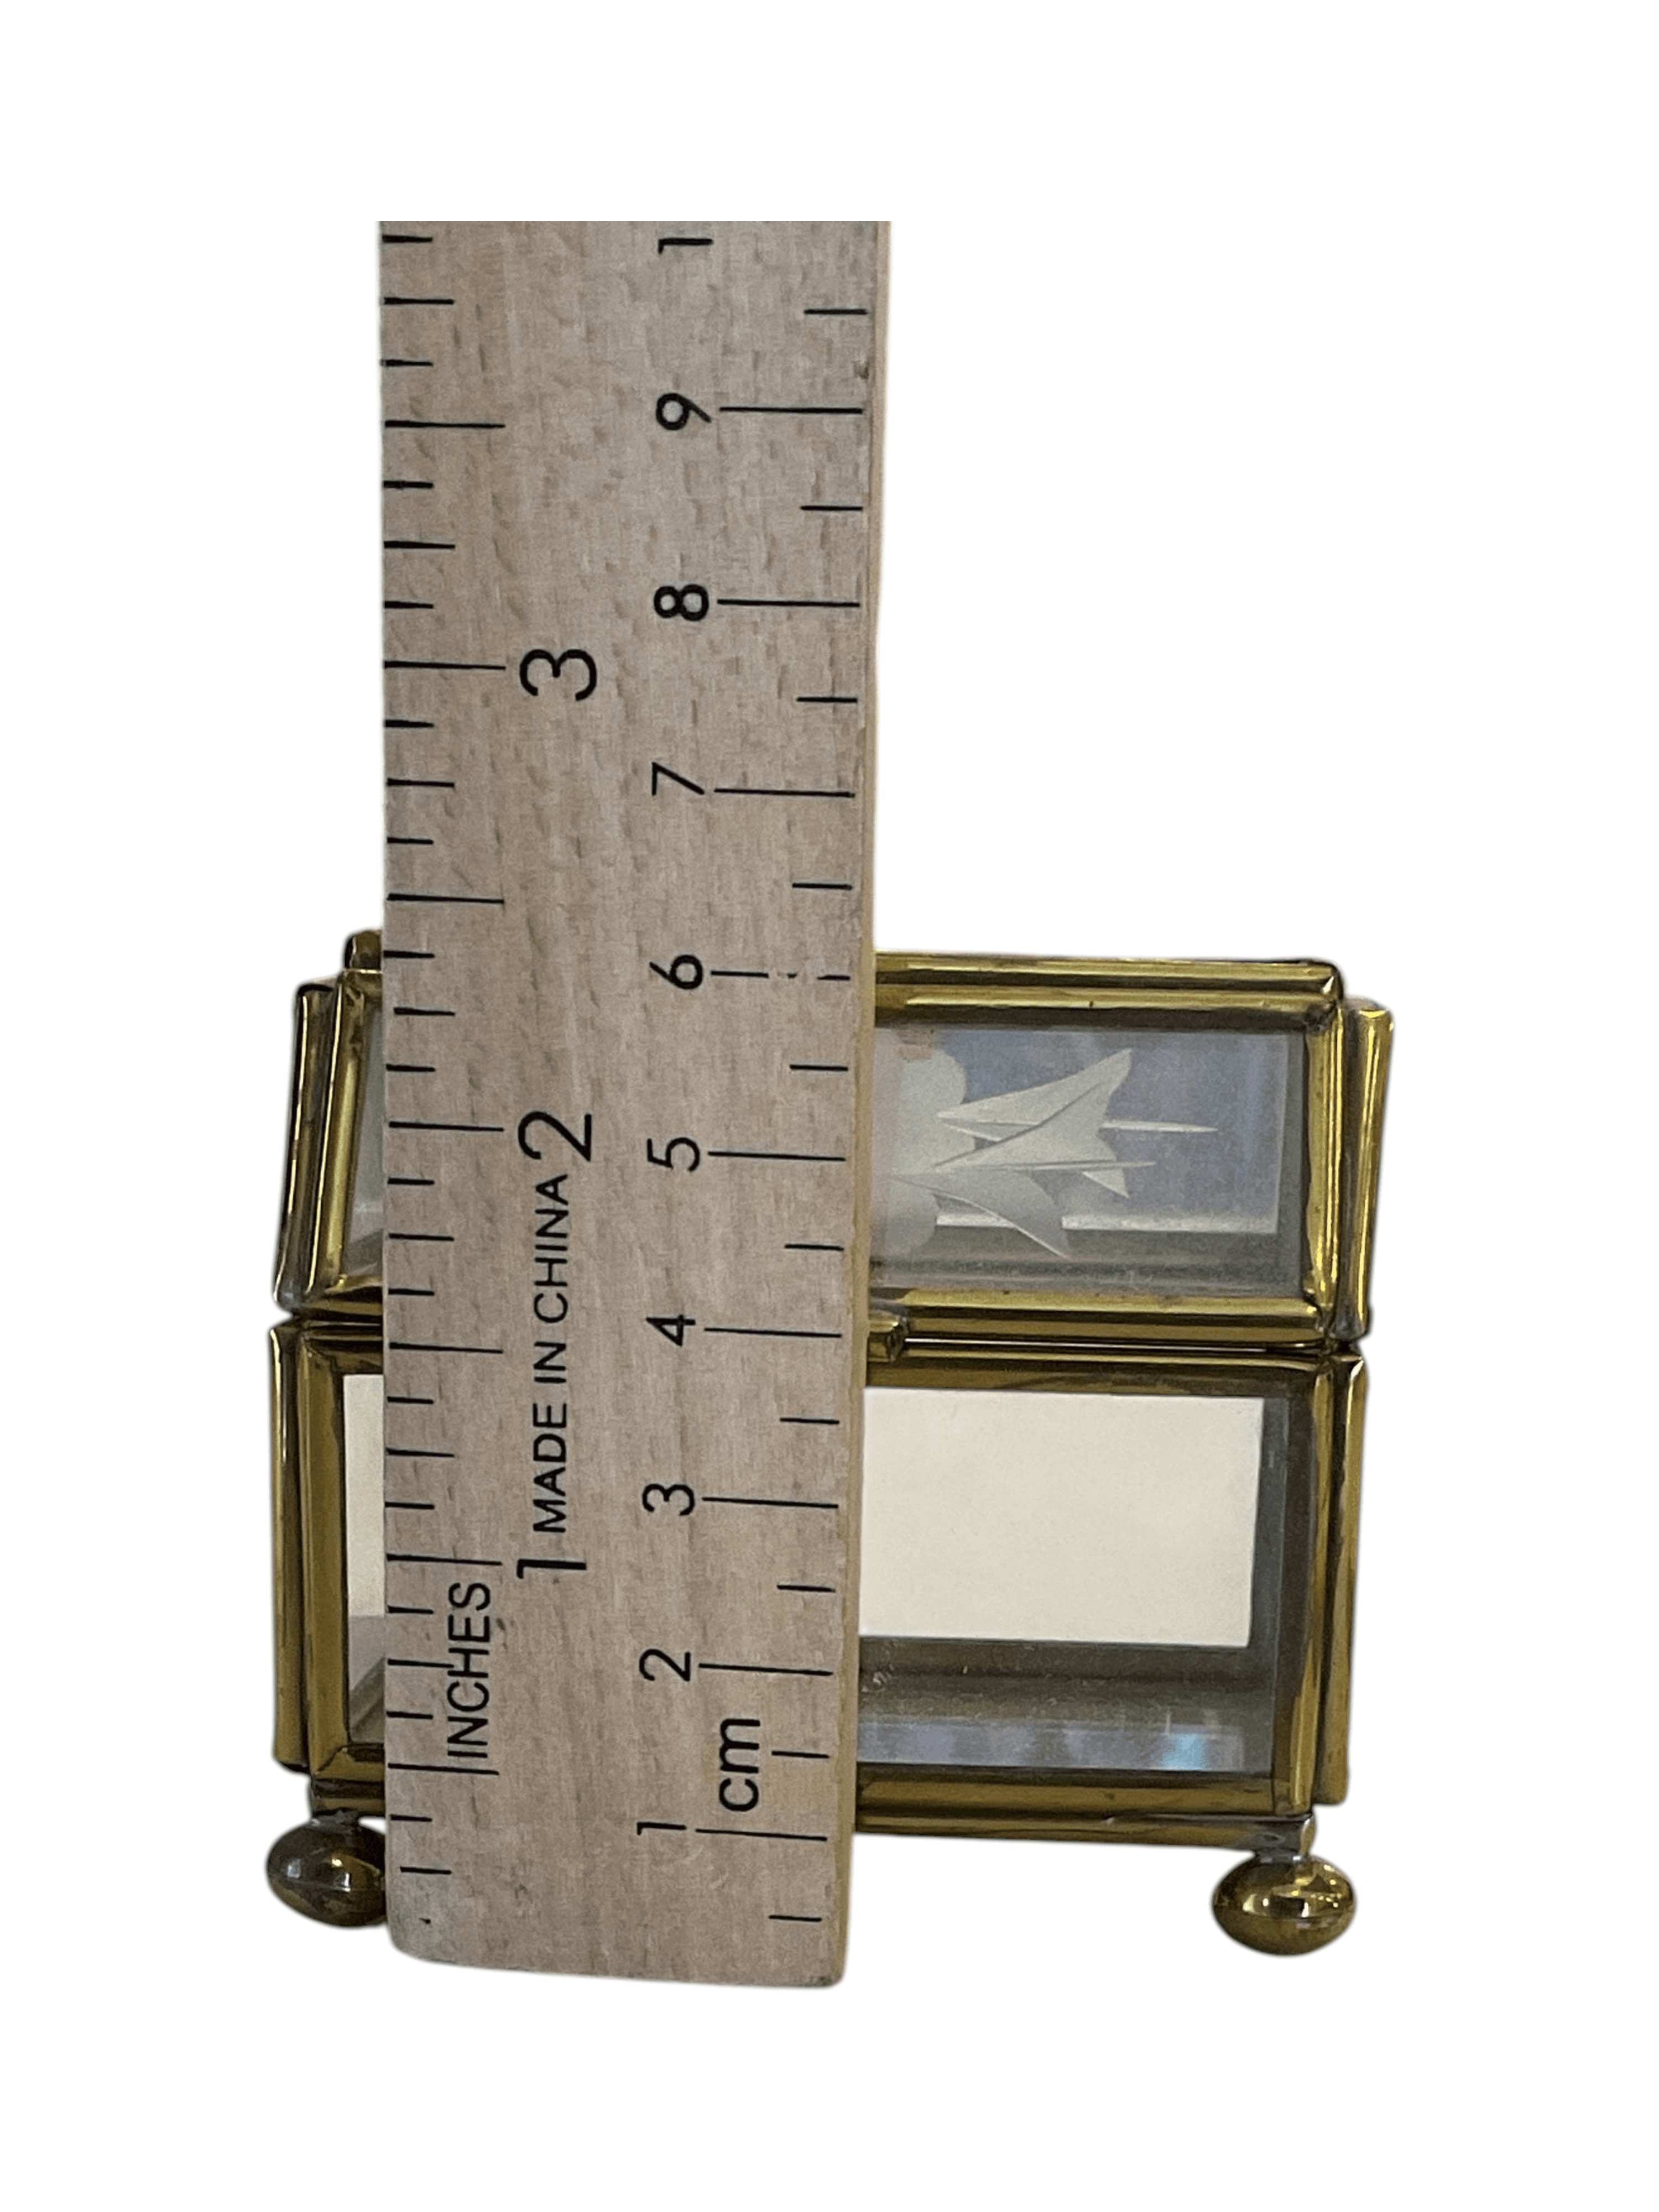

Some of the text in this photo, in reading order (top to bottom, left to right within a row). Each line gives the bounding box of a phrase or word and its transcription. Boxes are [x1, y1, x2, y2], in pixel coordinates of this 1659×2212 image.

[655, 392, 712, 431] 9
[653, 583, 710, 623] 8
[518, 648, 598, 702] 3
[651, 761, 706, 797] 7
[649, 953, 704, 991] 6
[517, 1110, 593, 1162] 2
[646, 1136, 701, 1173] 5
[645, 1313, 697, 1348] 4
[532, 1173, 570, 1534] MADE IN CHINA
[641, 1483, 696, 1517] 3
[515, 1558, 588, 1580] 1
[445, 1582, 492, 1759] INCHES
[638, 1648, 692, 1683] 2
[718, 1718, 761, 1813] cm
[635, 1821, 687, 1837] 1
